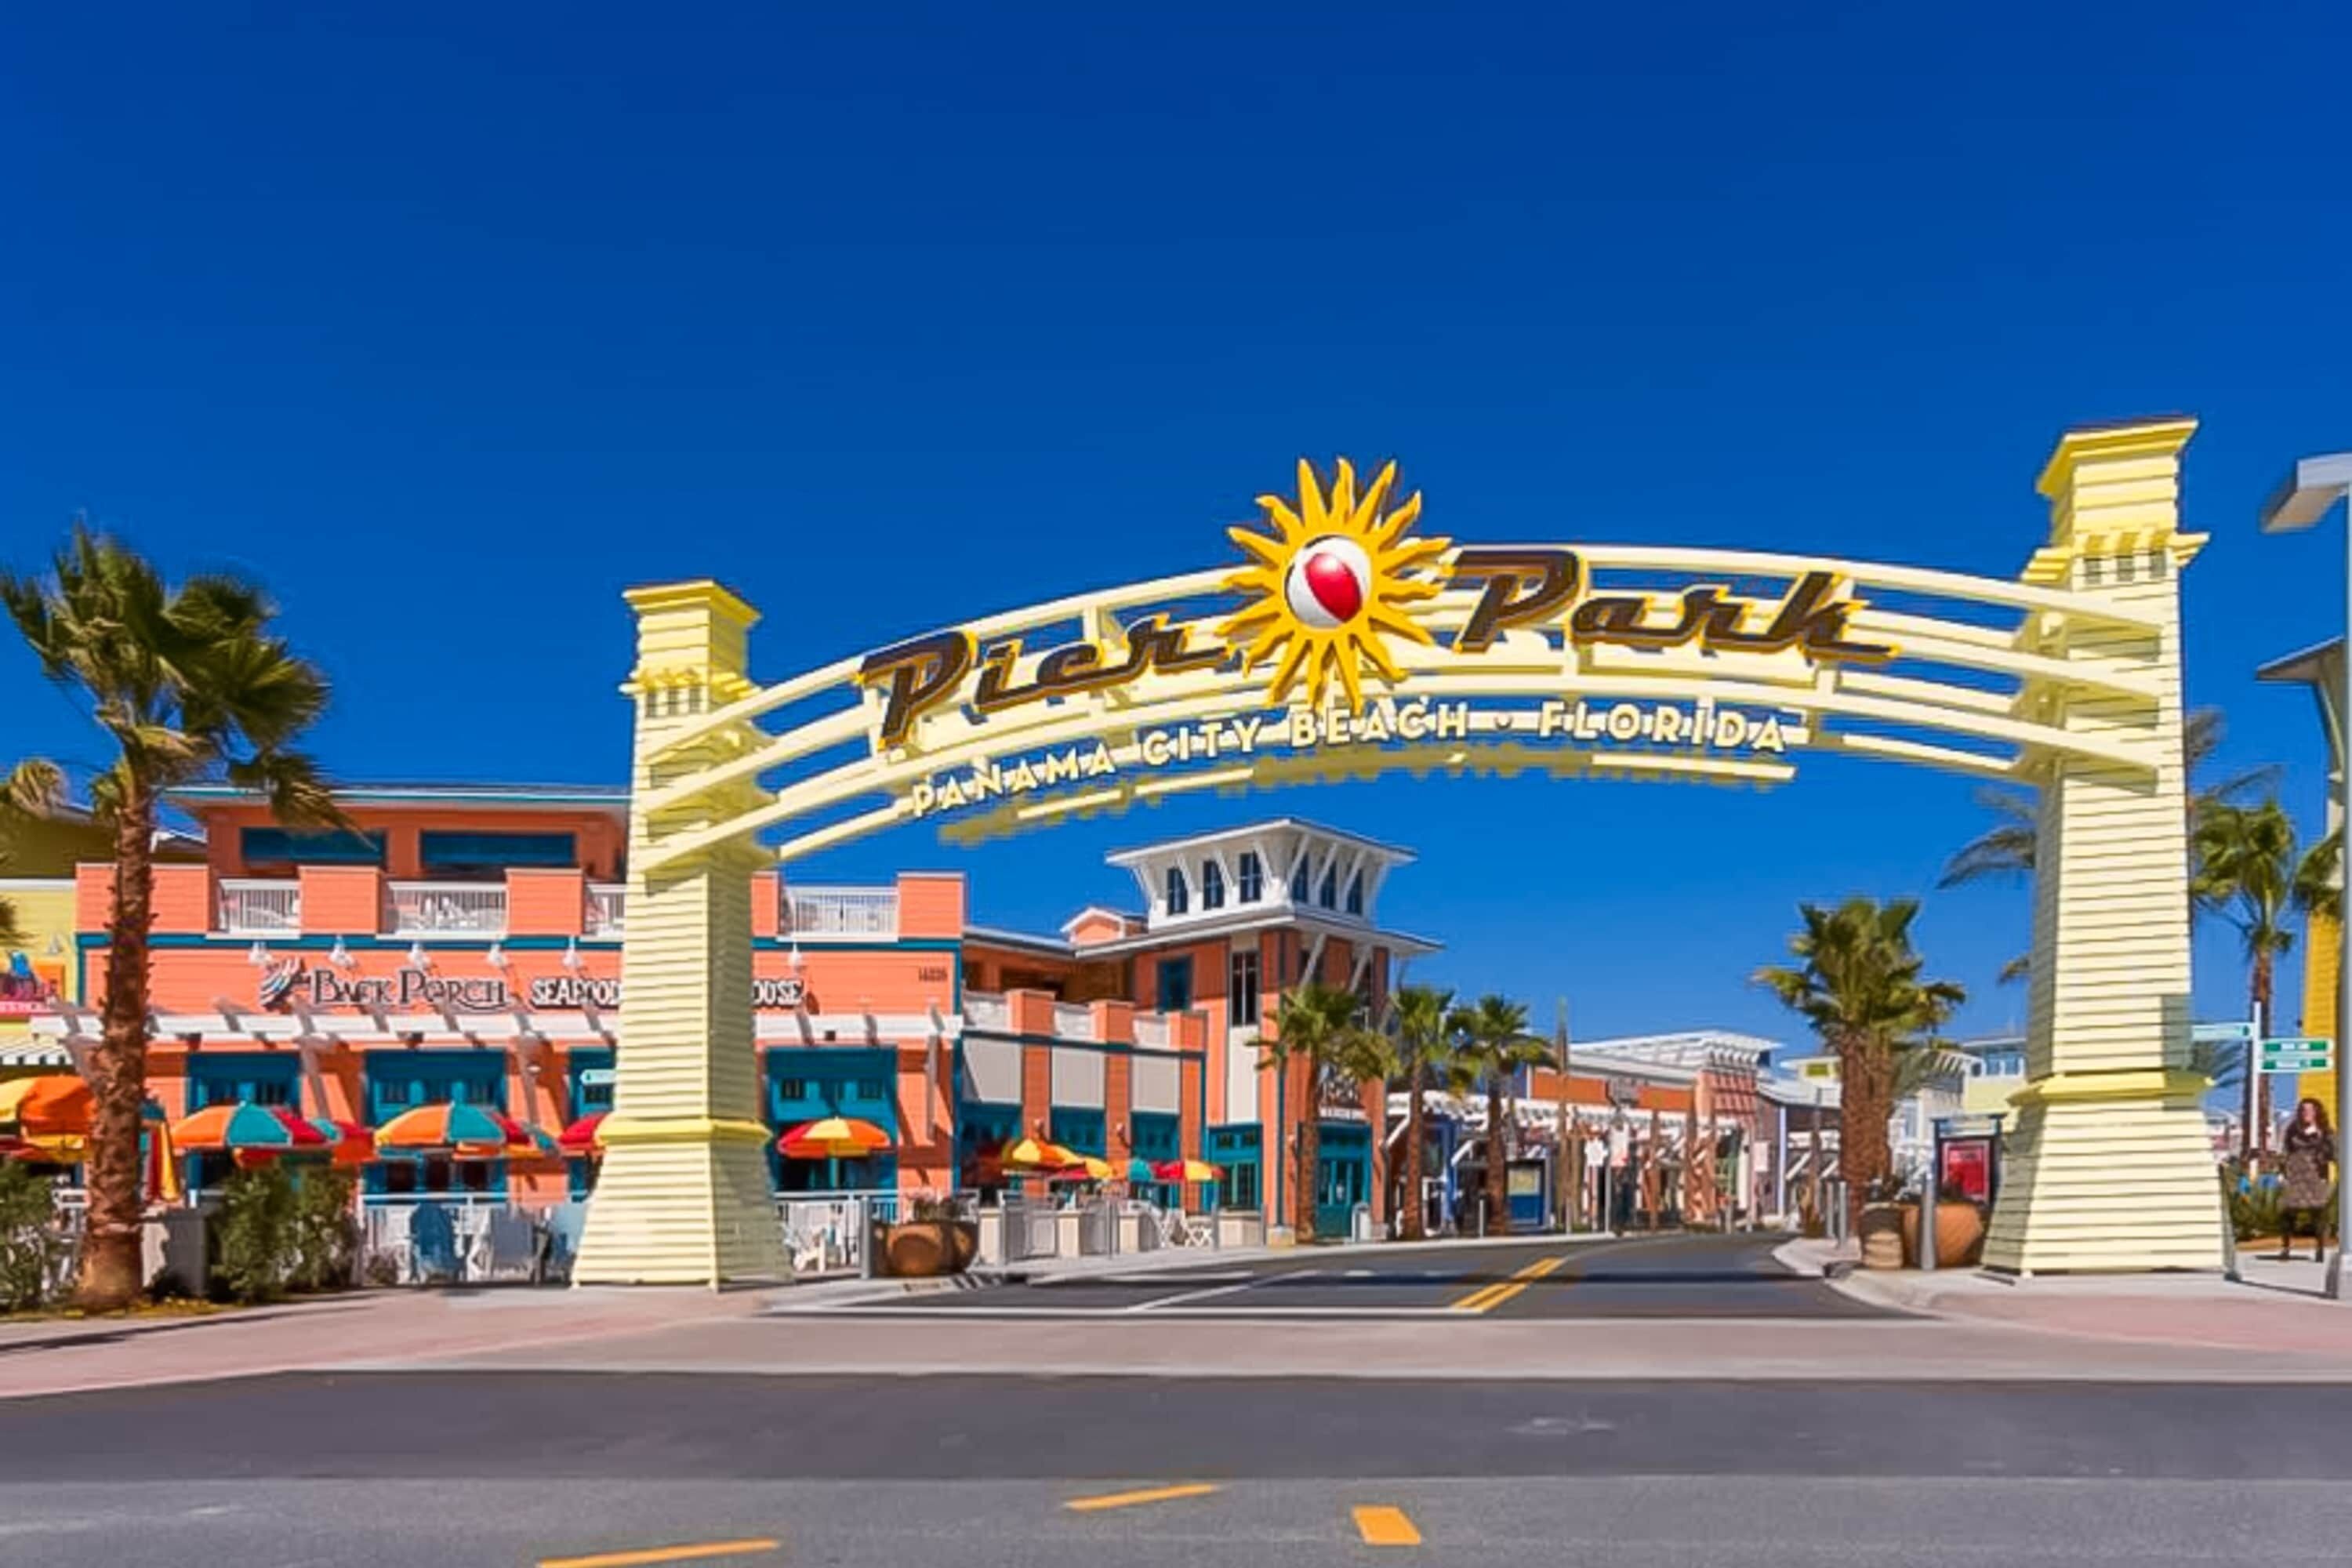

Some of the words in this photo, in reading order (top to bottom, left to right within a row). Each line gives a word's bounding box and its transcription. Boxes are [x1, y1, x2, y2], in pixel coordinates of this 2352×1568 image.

[857, 614, 1234, 751] Pier
[1443, 547, 1900, 662] Park
[912, 743, 1116, 817] PANAMA
[1142, 717, 1264, 768] CITY
[1290, 701, 1469, 749] BEACH
[1537, 699, 1787, 754] FLORIDA
[750, 979, 804, 1007] OUSE
